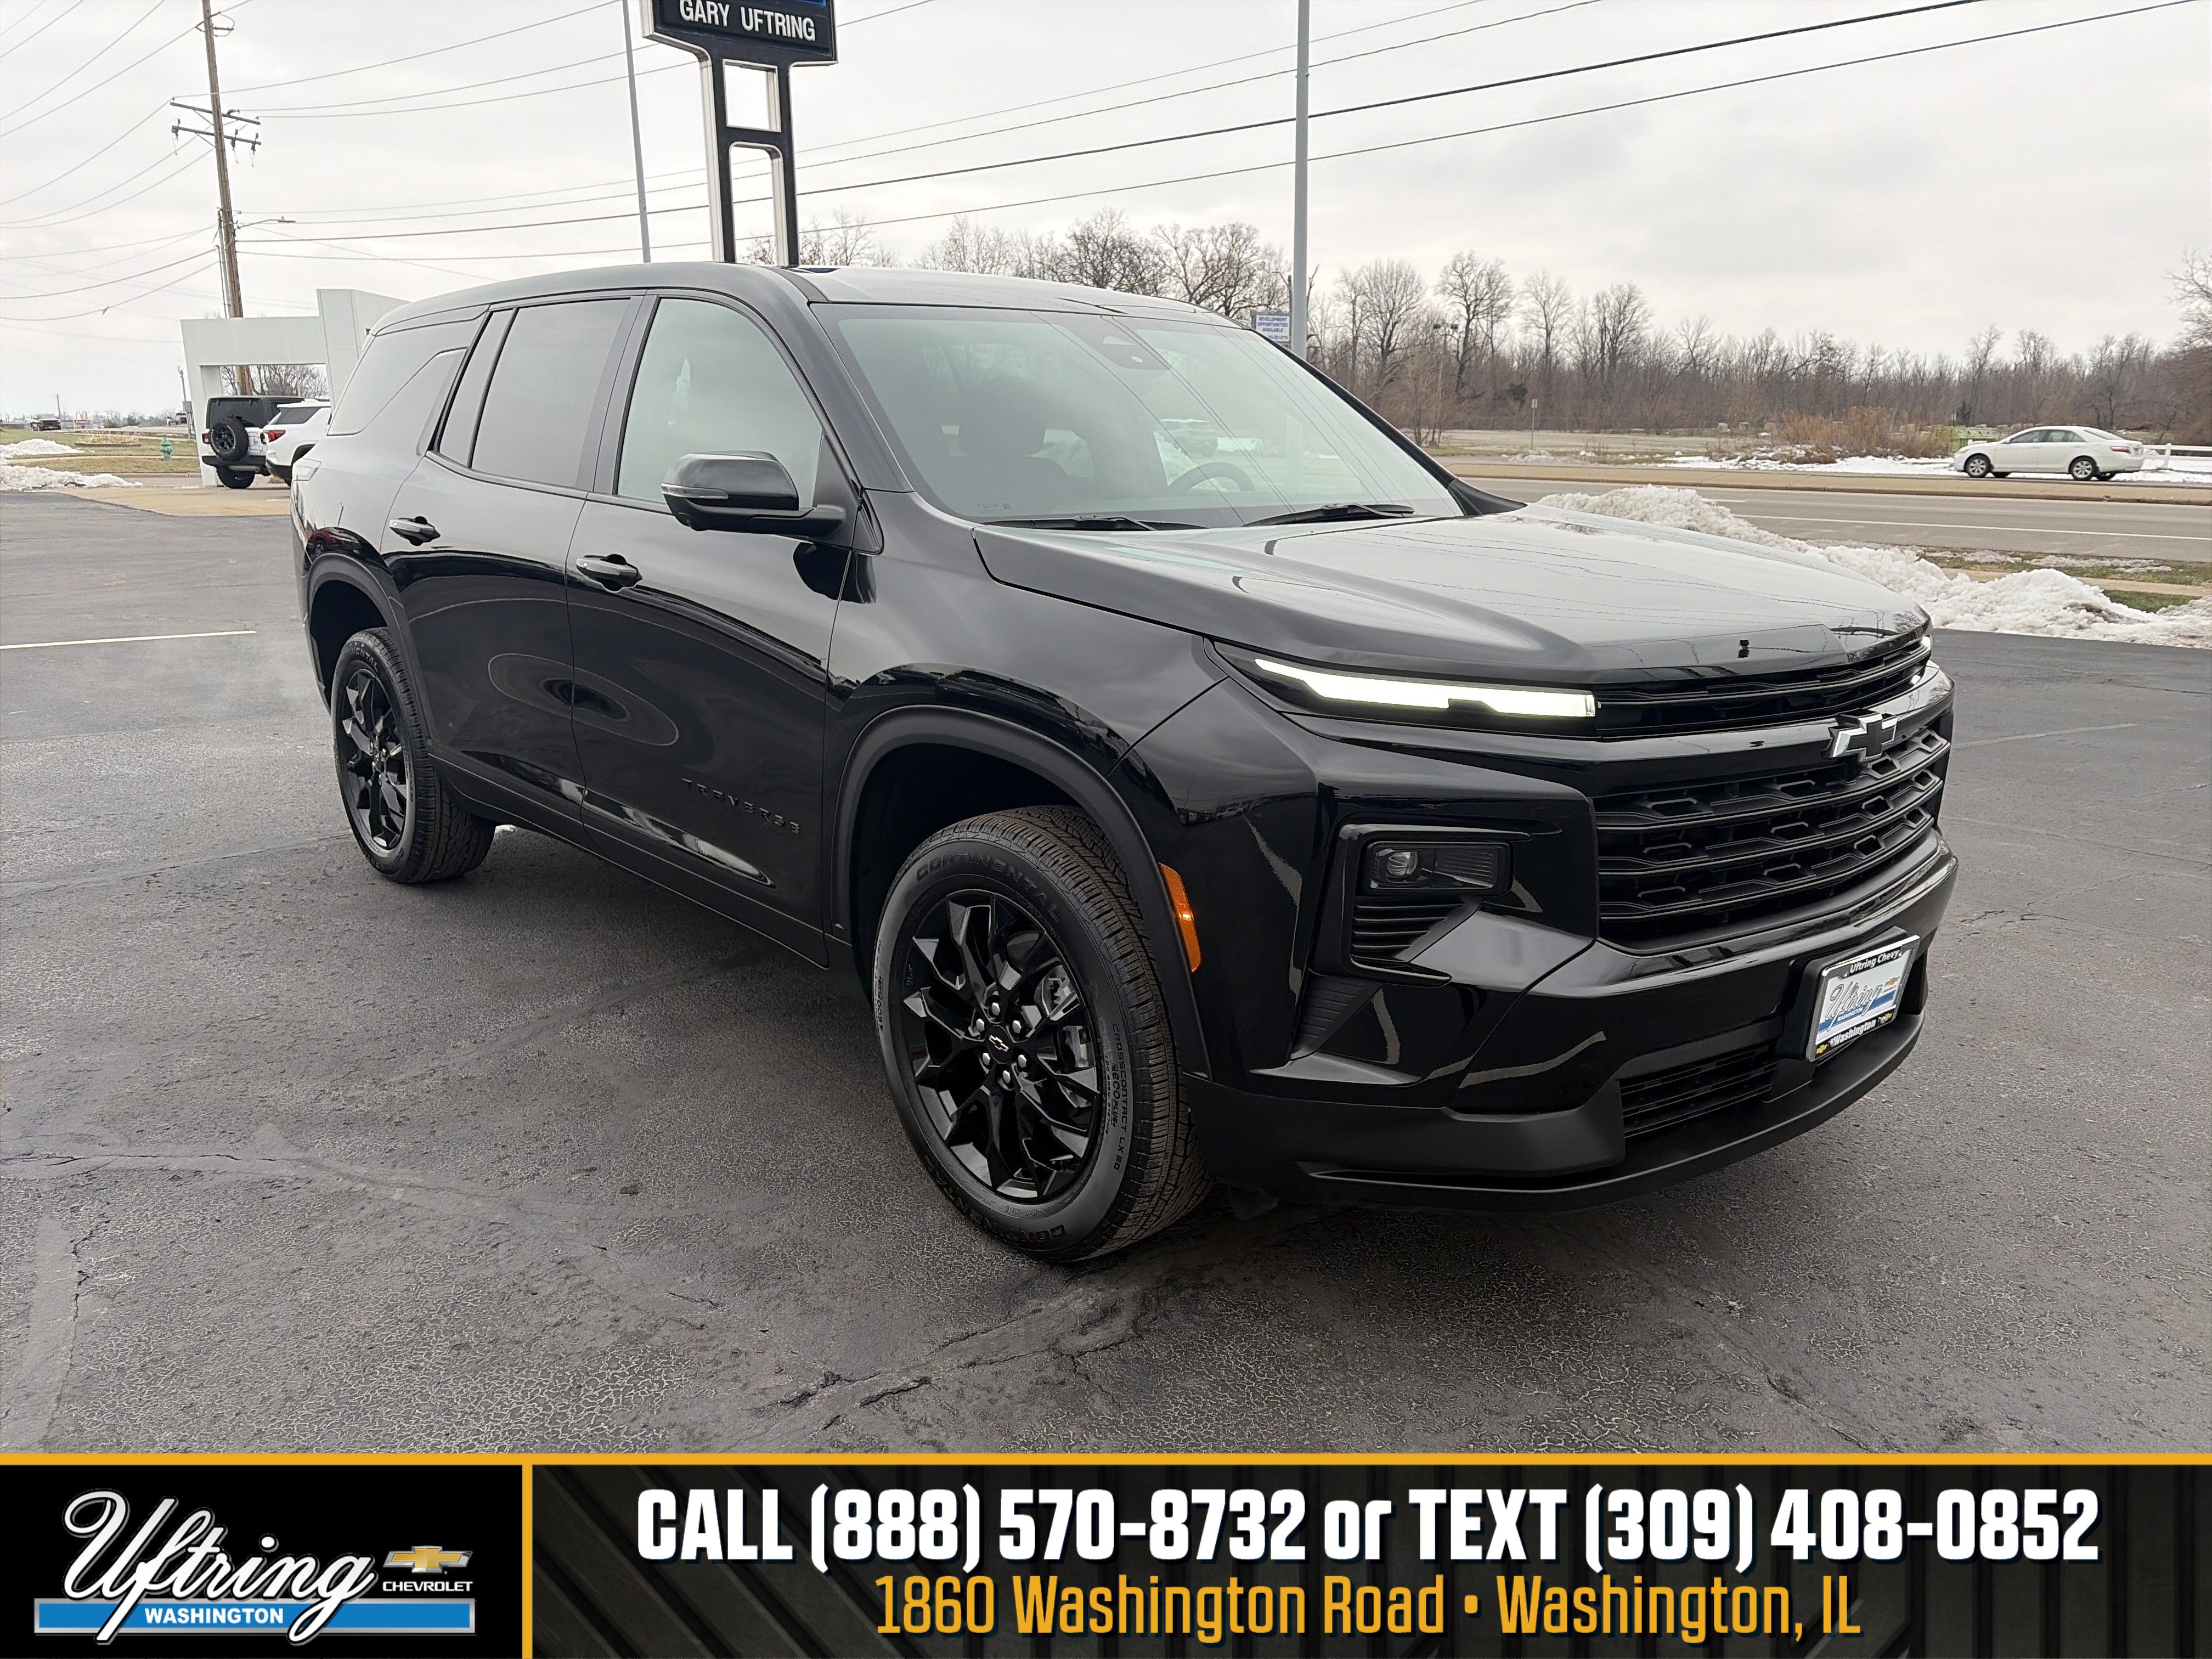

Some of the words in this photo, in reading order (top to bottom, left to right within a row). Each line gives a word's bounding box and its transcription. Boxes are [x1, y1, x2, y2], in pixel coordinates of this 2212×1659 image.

[679, 0, 730, 26] GARY
[741, 7, 816, 41] UFTRING
[681, 777, 802, 835] TRAVERSE
[916, 852, 1060, 923] CONTINENTAL
[1850, 958, 1877, 974] Uftring
[1877, 950, 1900, 963] Chevy
[1825, 981, 1883, 1032] Uftring
[1833, 1019, 1877, 1046] Washington
[1111, 1023, 1128, 1132] CROSSCONTACT
[1118, 1137, 1126, 1154] LX
